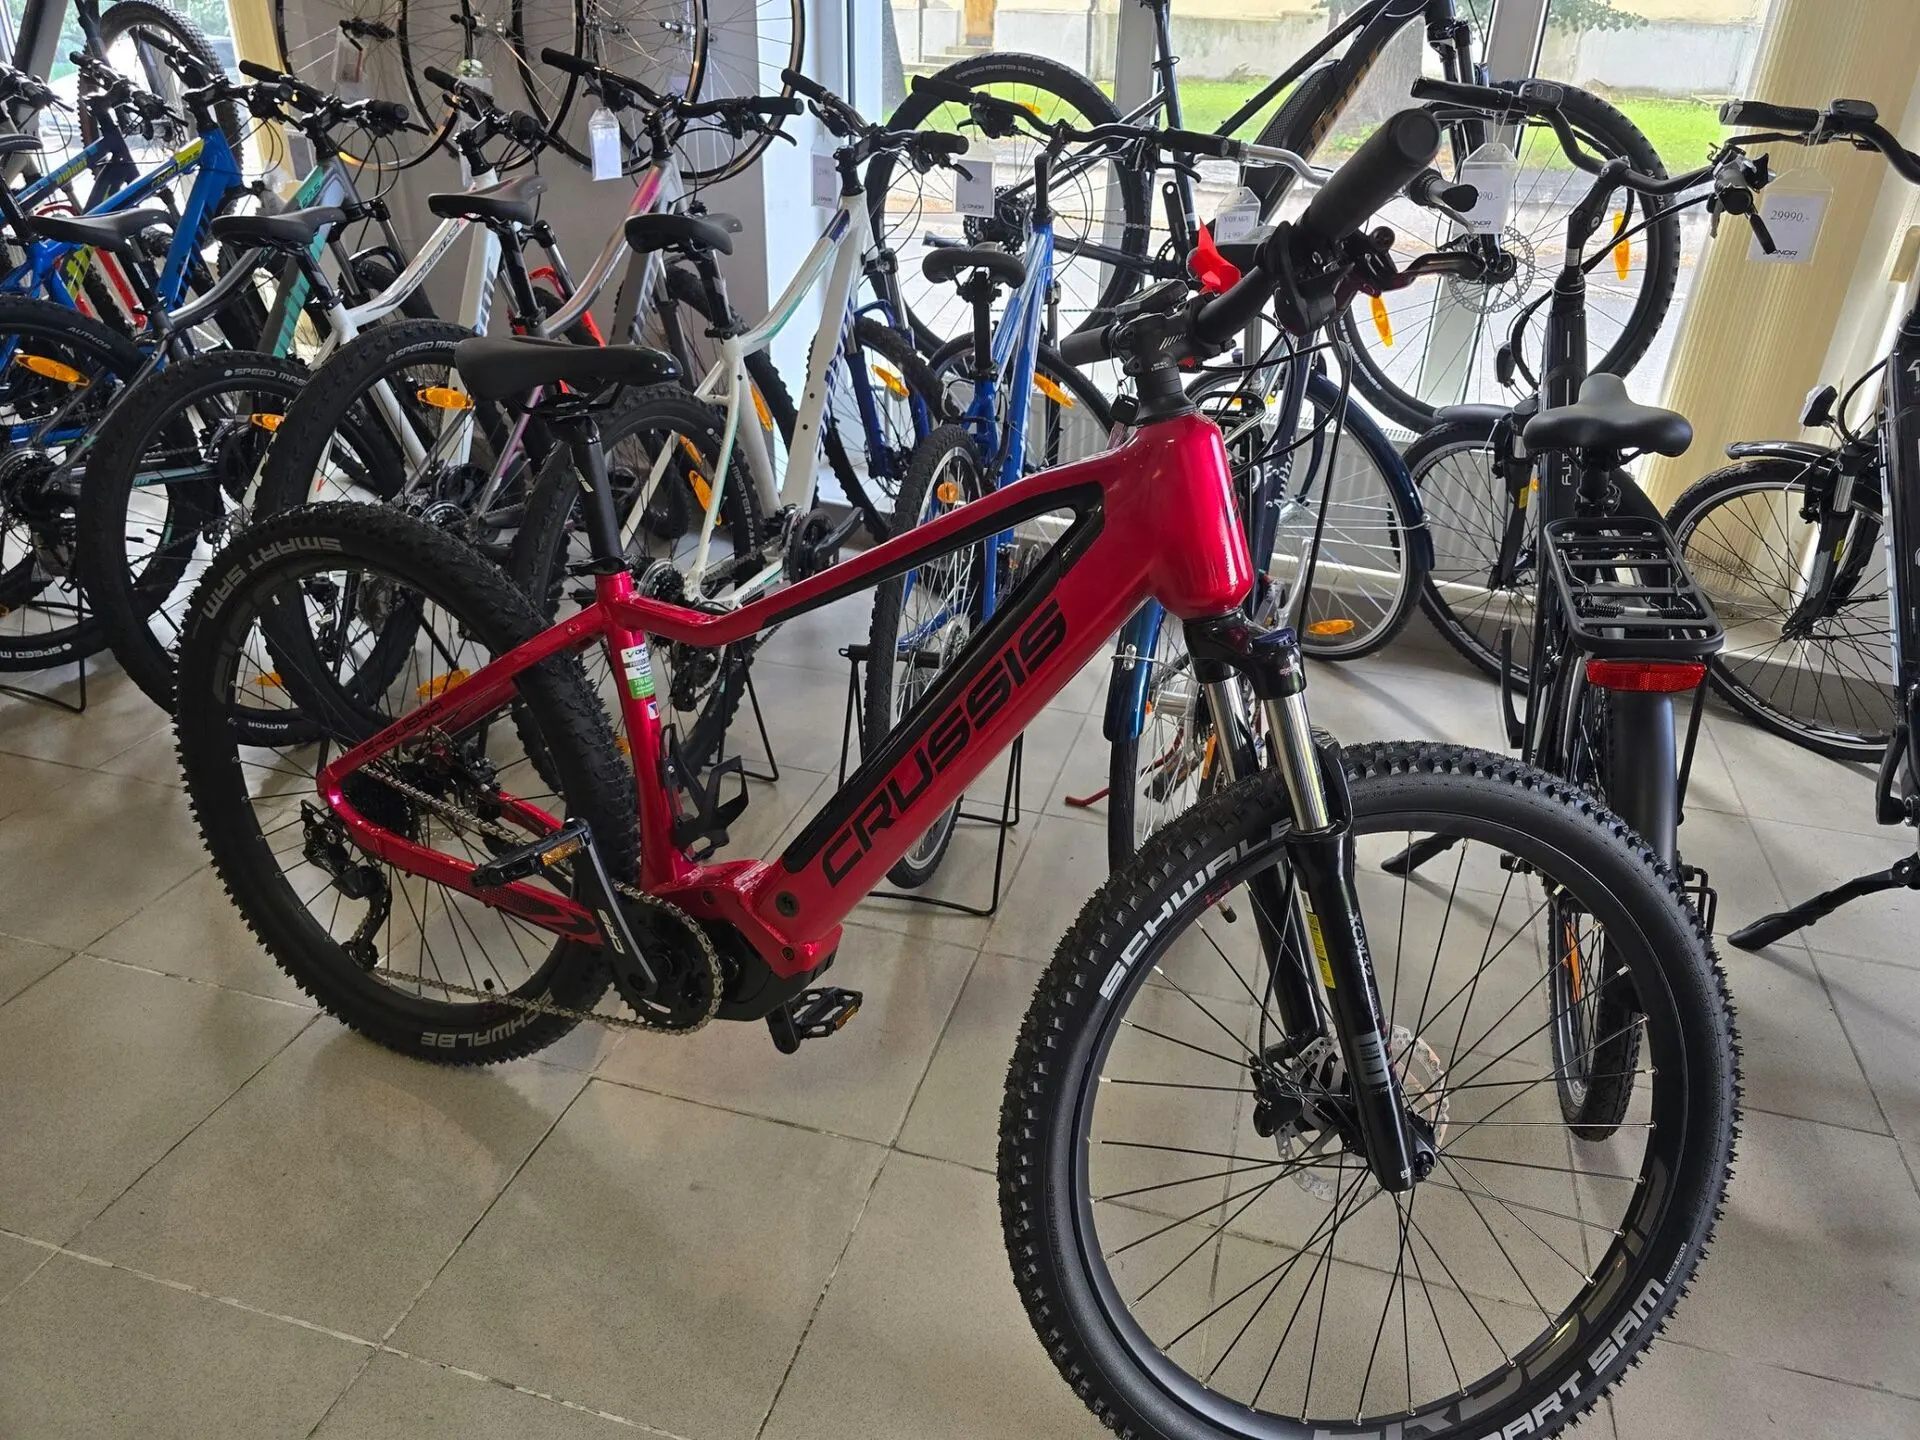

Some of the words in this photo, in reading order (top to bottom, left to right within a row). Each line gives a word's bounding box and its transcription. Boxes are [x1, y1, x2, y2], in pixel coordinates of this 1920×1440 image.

[67, 326, 112, 351] AUTHOR
[393, 341, 434, 355] SPEED
[234, 368, 276, 378] SPEED
[278, 372, 308, 386] MAS
[731, 464, 752, 517] MASTER
[248, 536, 343, 571] SMART
[202, 564, 248, 620] SAM
[248, 721, 289, 731] AUTHOR
[822, 599, 1068, 888] CRUSSIS
[1099, 817, 1292, 1001] SCHWALB
[1588, 1278, 1665, 1376] SAM
